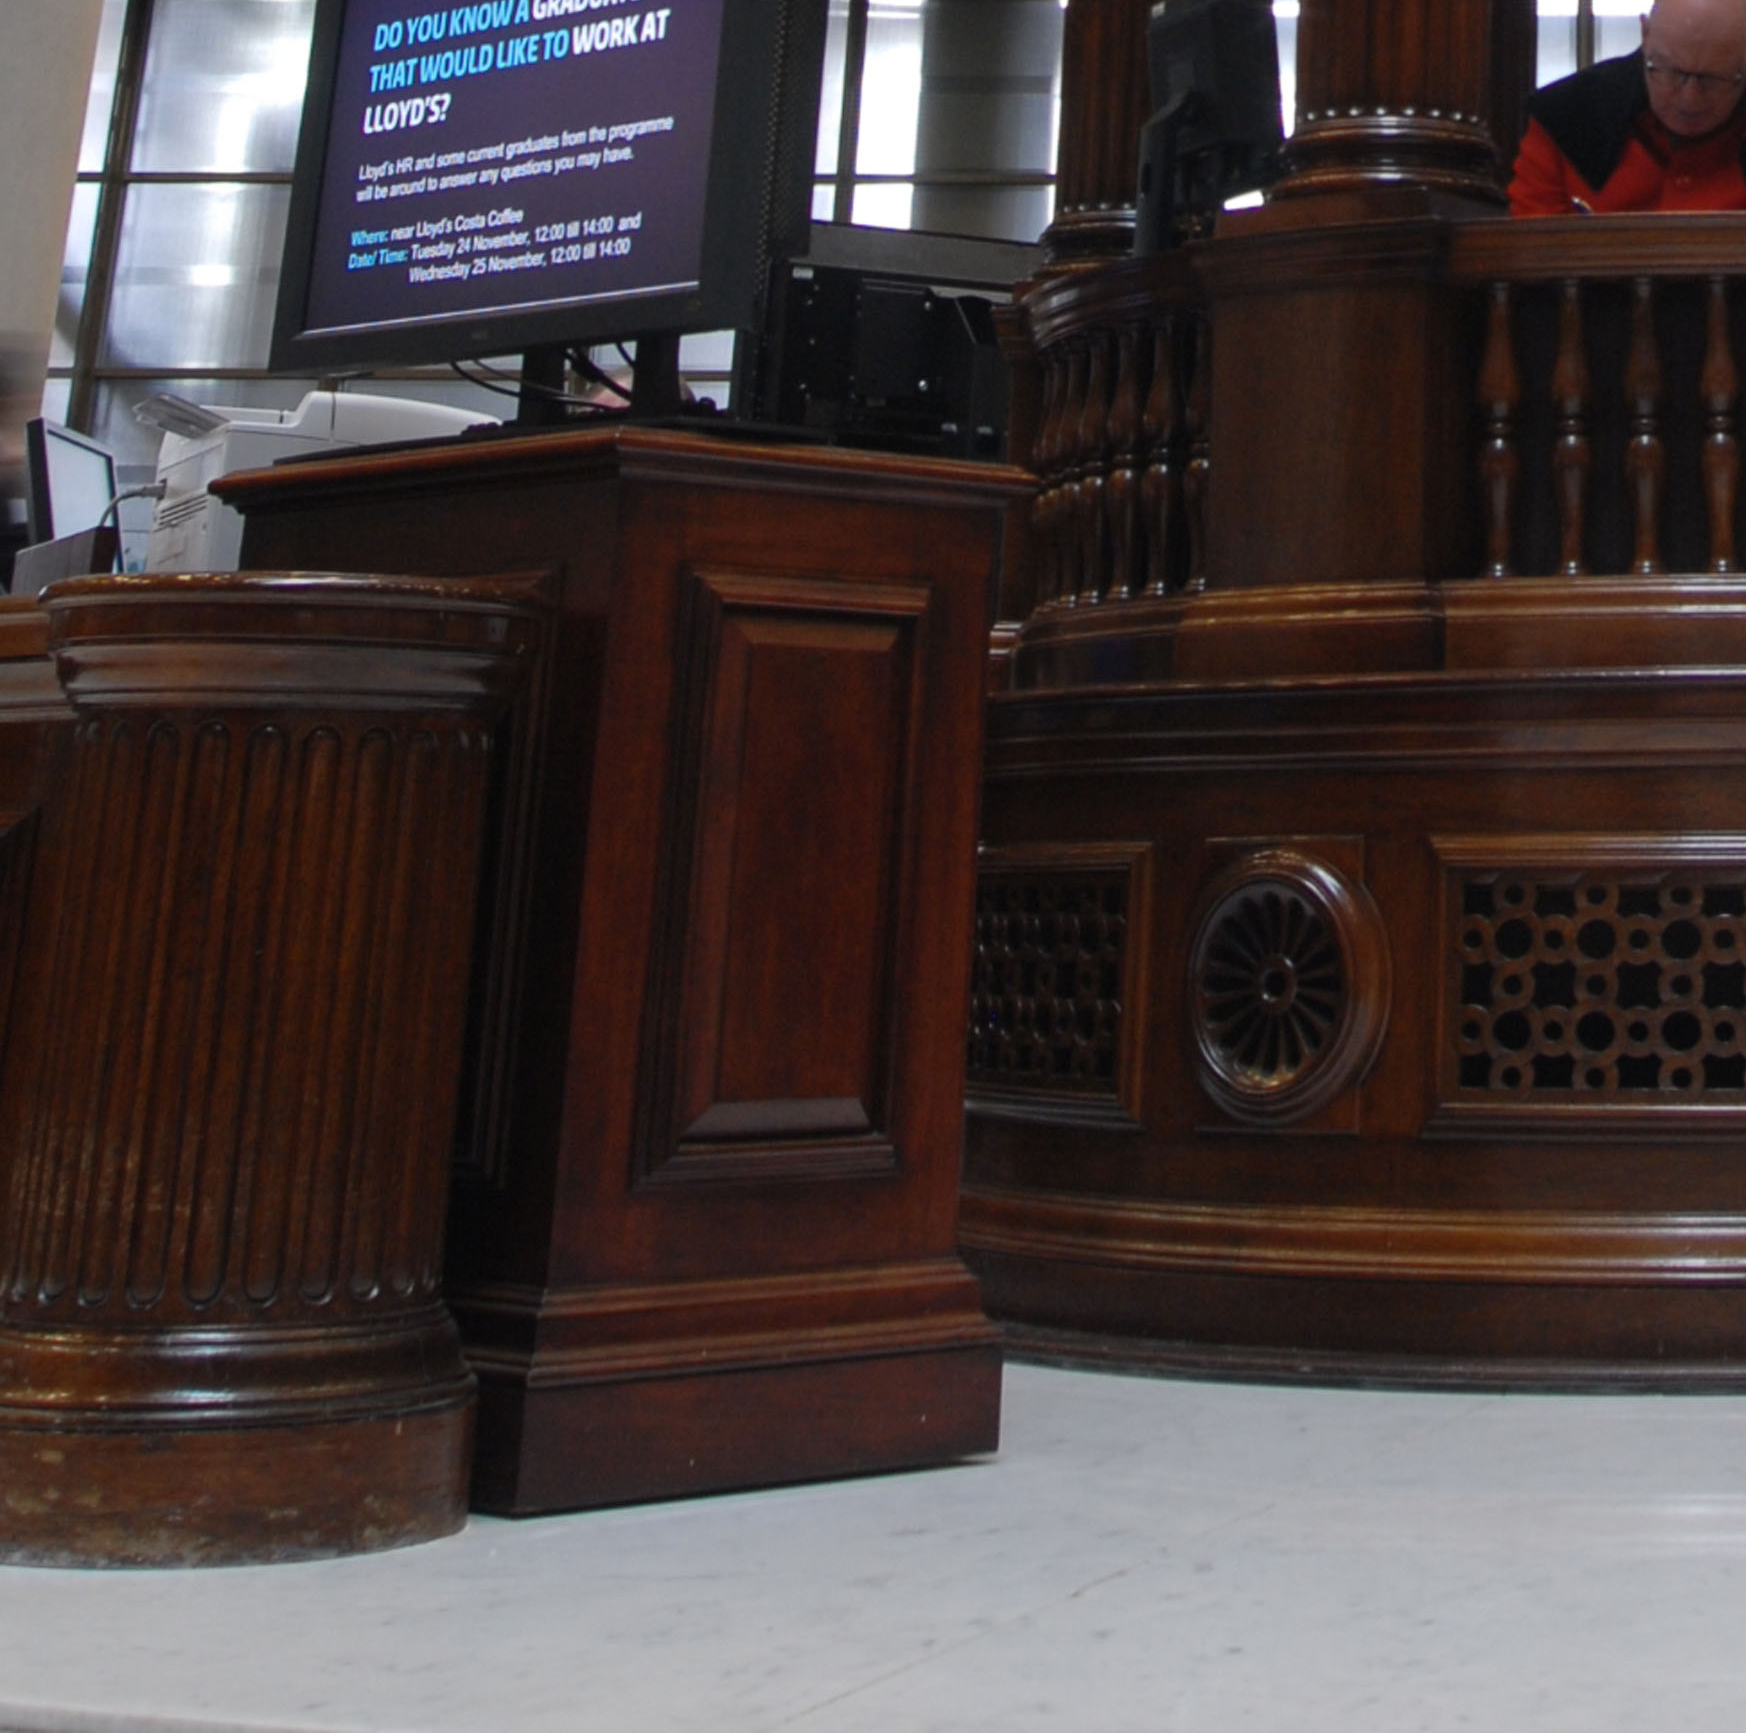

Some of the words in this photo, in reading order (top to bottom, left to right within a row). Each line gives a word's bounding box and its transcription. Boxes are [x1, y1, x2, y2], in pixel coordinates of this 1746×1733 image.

[370, 59, 417, 92] THAT
[419, 45, 493, 83] WOULD
[497, 35, 538, 68] LIKE
[544, 30, 568, 59] TO
[573, 16, 638, 54] WORK
[641, 9, 670, 42] AT
[375, 22, 401, 51] DO
[407, 13, 446, 44] YOU
[364, 94, 451, 133] LLOYD'S?
[359, 162, 394, 181] Lloyd's
[397, 157, 414, 173] HR
[415, 153, 435, 171] and
[437, 152, 465, 167] some
[467, 142, 504, 162] current
[506, 137, 559, 160] graduates
[562, 131, 586, 147] from
[589, 126, 606, 142] the
[609, 117, 674, 143] programme
[375, 184, 388, 199] be
[390, 177, 426, 196] around
[428, 177, 437, 190] to
[440, 172, 477, 188] answer
[480, 169, 500, 184] any
[502, 160, 552, 181] questions
[554, 157, 575, 174] you
[577, 152, 601, 168] may
[391, 226, 415, 240] near
[416, 218, 452, 238] Lloyd's
[455, 216, 485, 231] Costa
[488, 208, 524, 226] Coffee
[412, 241, 456, 260] Tuesday
[457, 237, 471, 253] 24
[473, 232, 530, 250] November,
[535, 224, 564, 242] 12:00
[584, 216, 613, 235] 14:00
[618, 212, 642, 230] and
[410, 262, 471, 282] Wednesday
[473, 257, 486, 274] 25
[488, 251, 546, 272] November,
[552, 244, 581, 263] 12:00
[600, 238, 631, 256] 14:00
